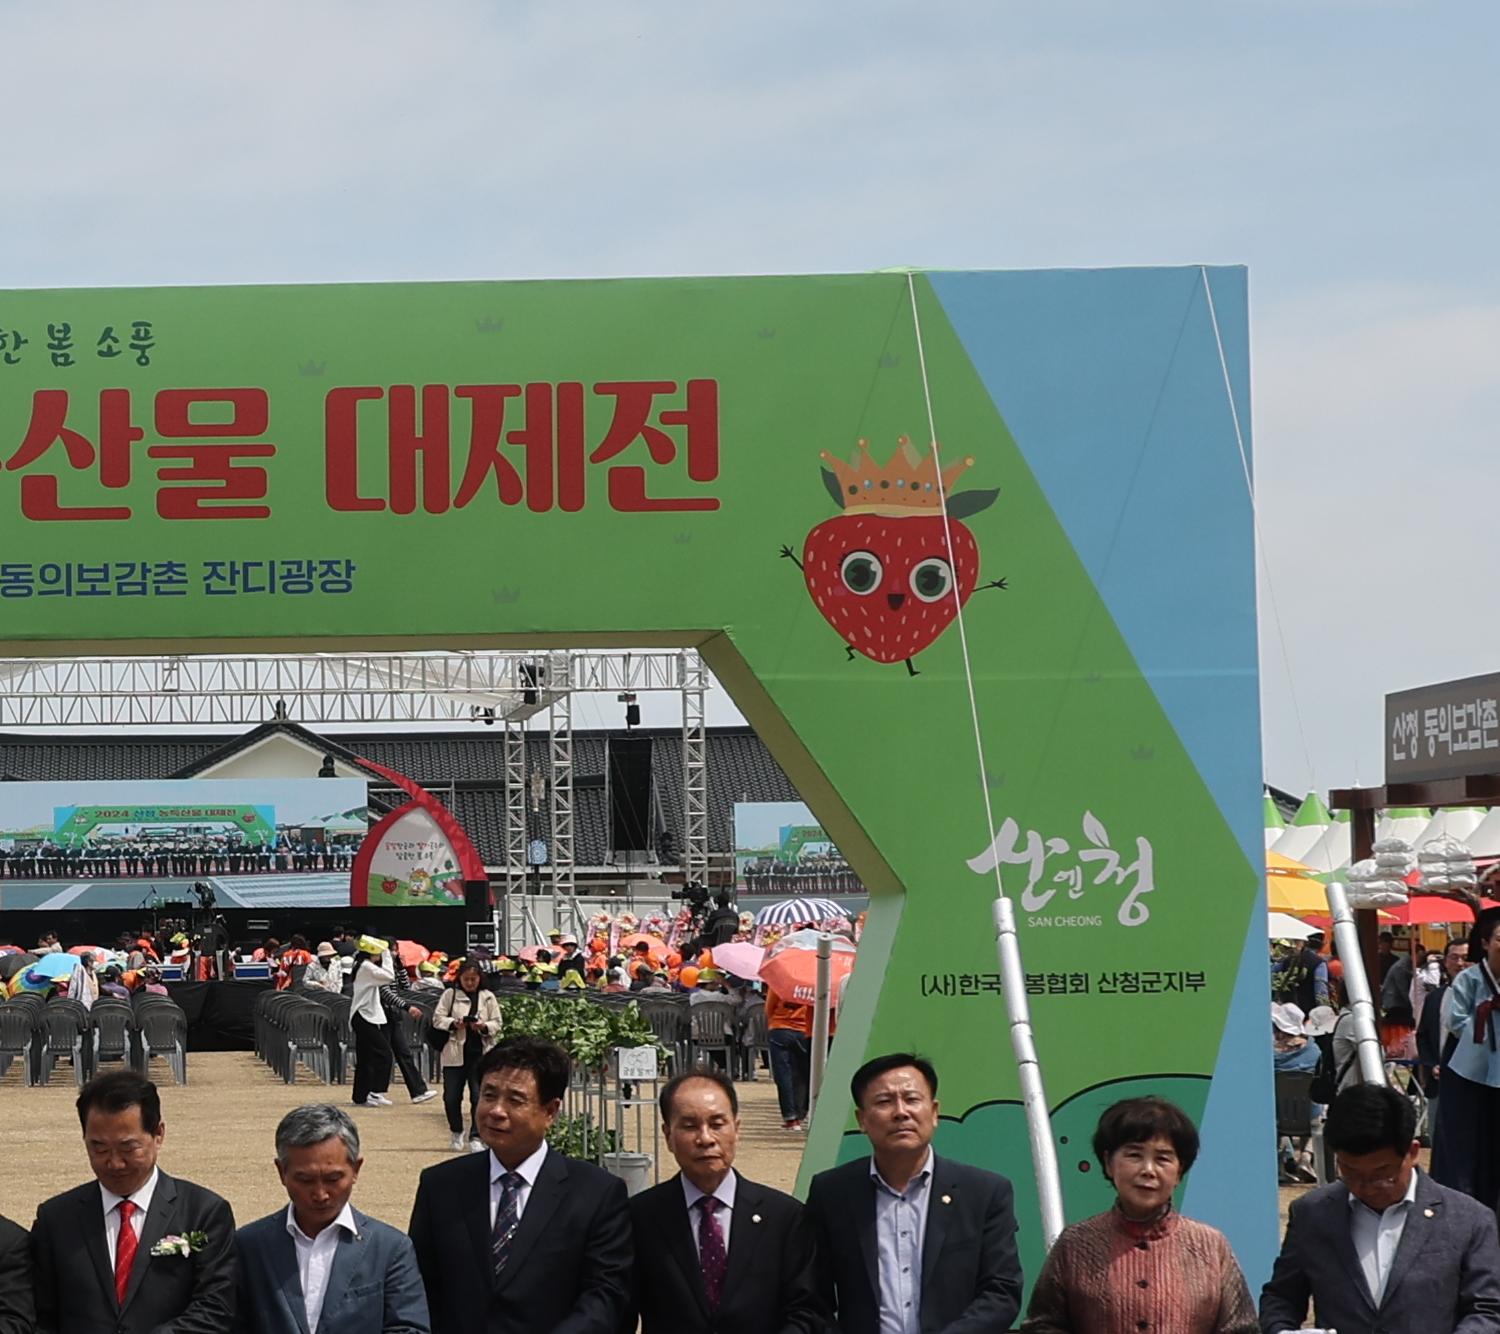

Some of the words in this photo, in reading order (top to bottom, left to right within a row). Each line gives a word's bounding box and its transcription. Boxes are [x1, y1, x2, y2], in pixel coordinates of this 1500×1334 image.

[46, 322, 76, 367] 봄
[96, 320, 156, 367] 소풍
[322, 378, 720, 516] 대제전
[202, 558, 356, 597] 잔디광장
[1392, 709, 1419, 761] 산청
[1424, 698, 1499, 758] 동의보감촌
[1028, 916, 1052, 927] SAN
[1054, 916, 1102, 927] CHEONG
[920, 972, 1090, 997] (사)한국봉협회
[1097, 971, 1207, 995] 산청군지부
